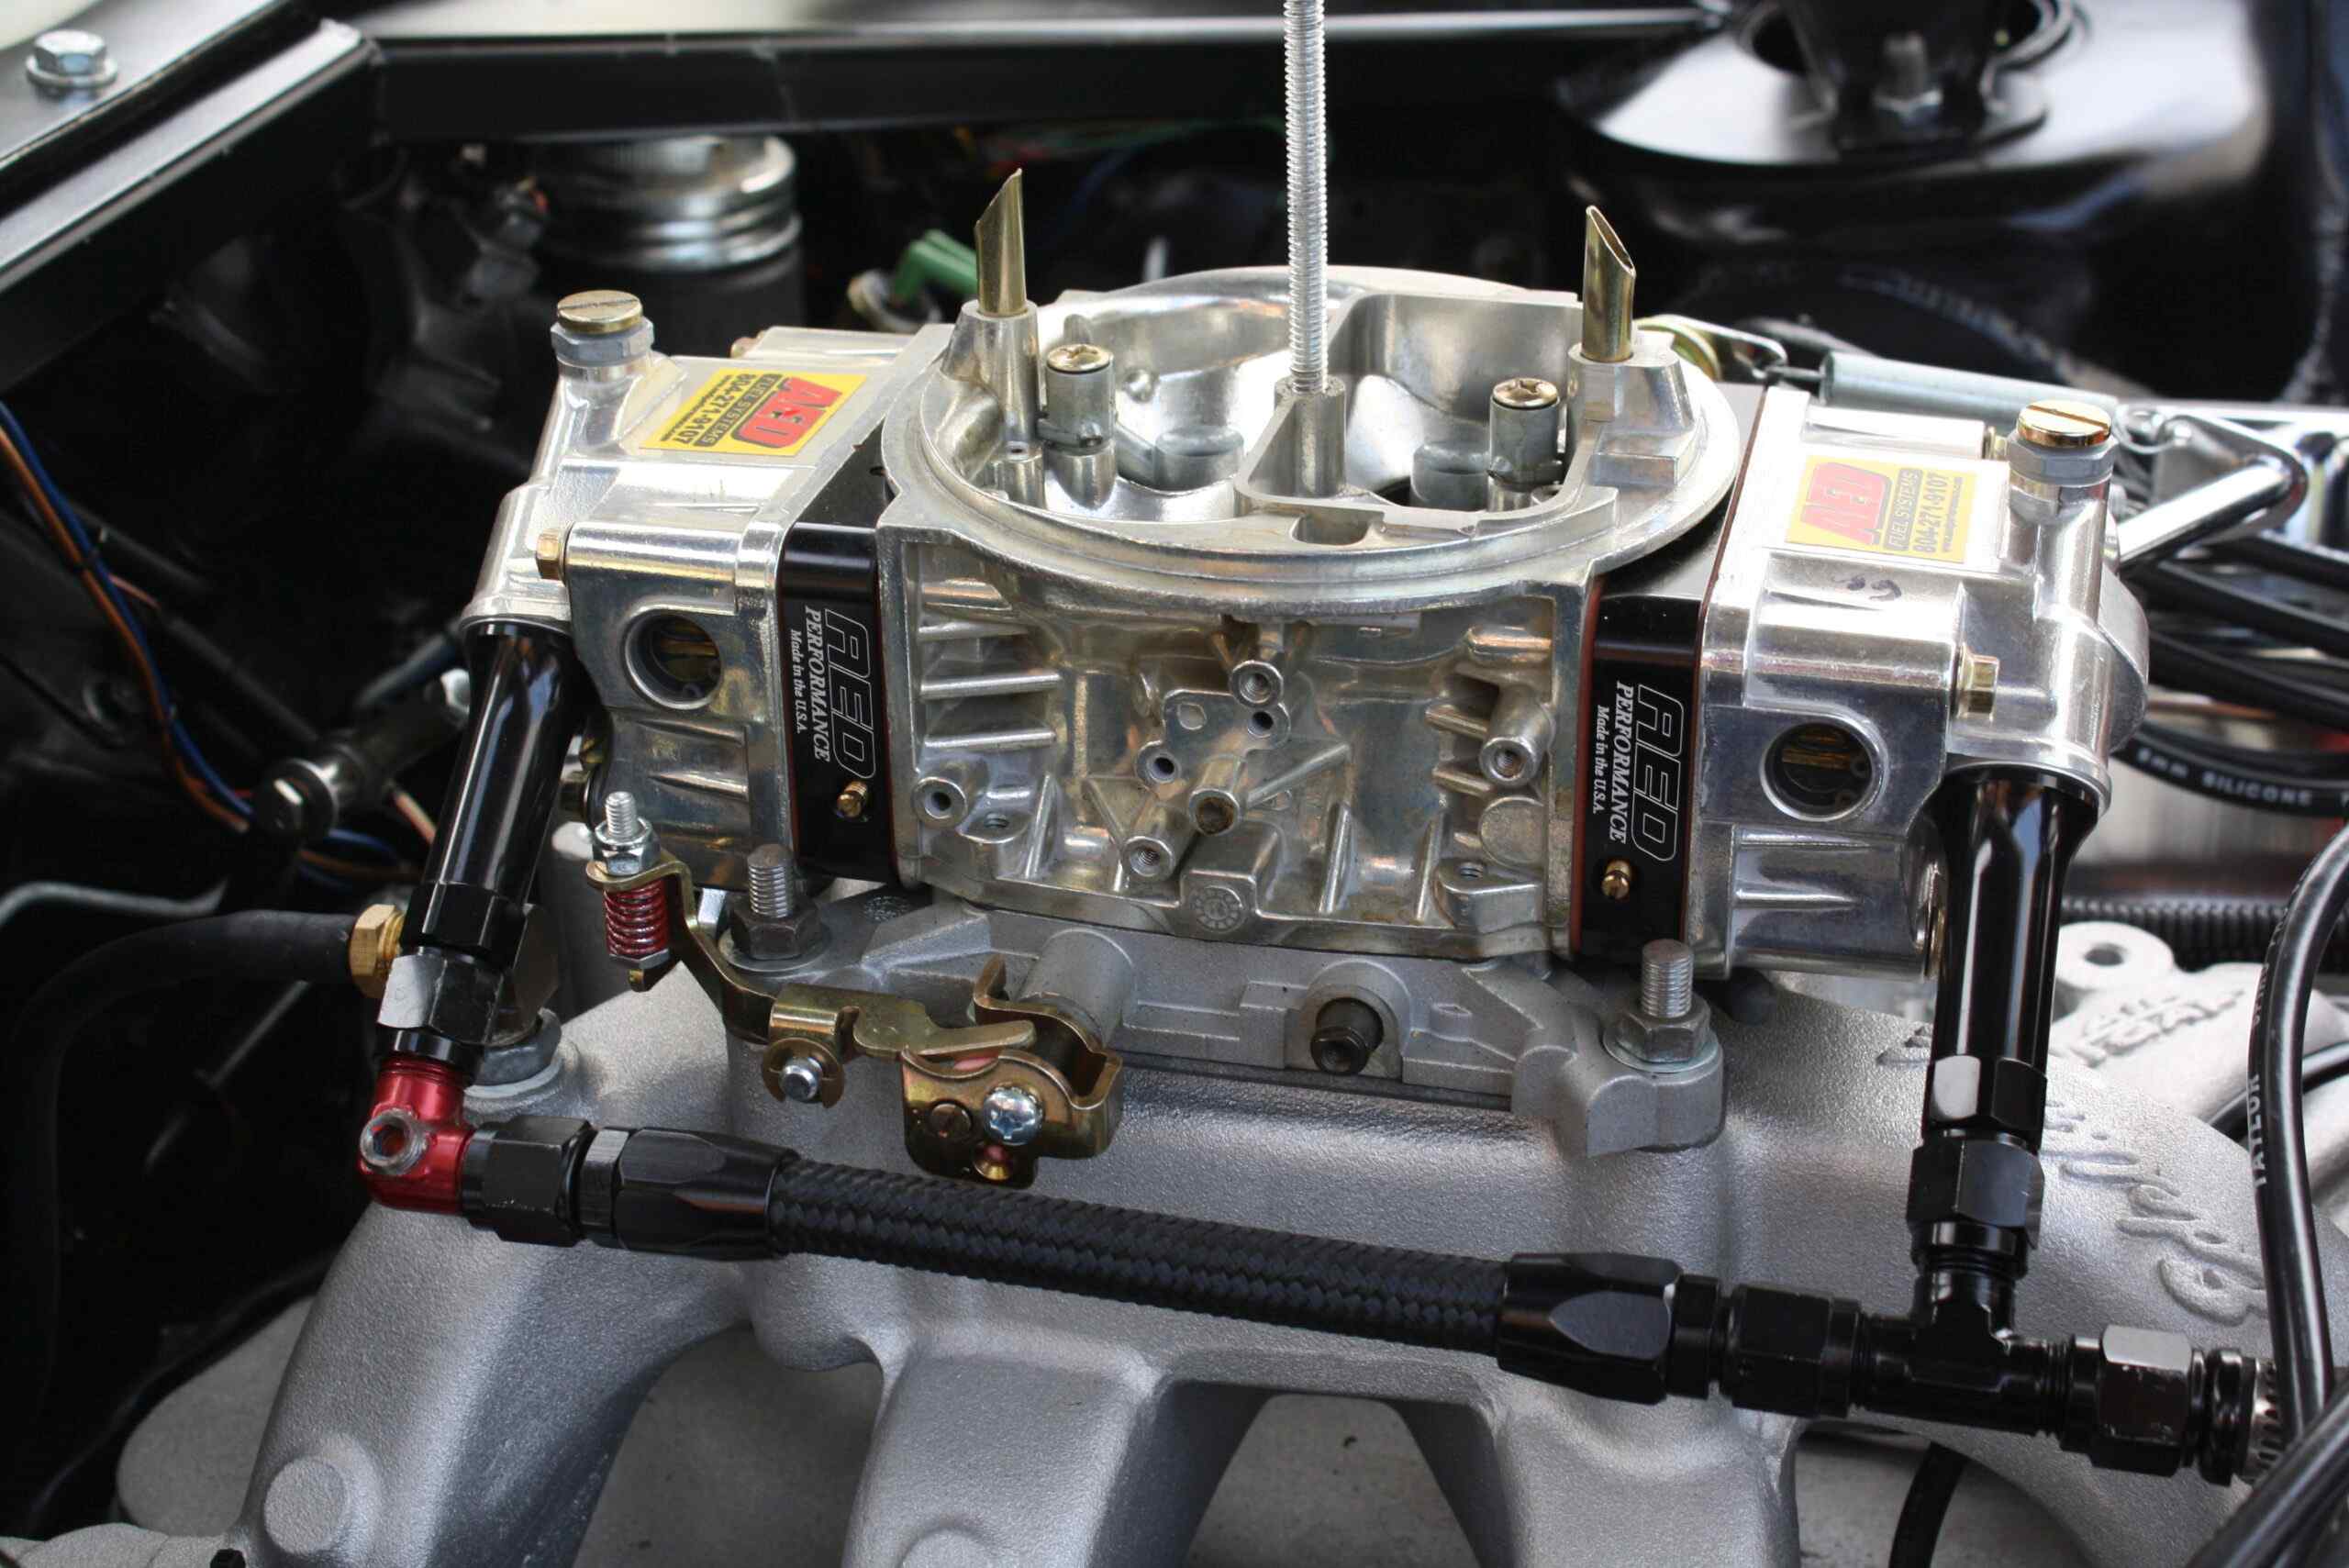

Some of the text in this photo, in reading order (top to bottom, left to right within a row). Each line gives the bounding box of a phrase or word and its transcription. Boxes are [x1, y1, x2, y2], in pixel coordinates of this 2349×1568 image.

[705, 400, 755, 444] SYSTEMS
[732, 376, 843, 448] AED
[1800, 462, 1893, 545] AED
[1888, 472, 1918, 548] FUEL SYSTEMS
[1912, 472, 1948, 552] 804-271-9107
[791, 628, 804, 663] Made
[792, 664, 805, 677] in
[794, 677, 807, 698] the
[805, 606, 830, 762] PERFORMANCE
[825, 608, 876, 779] AED
[1596, 742, 1609, 755] in
[1597, 705, 1609, 740] Made
[1595, 757, 1609, 776] the
[1609, 680, 1634, 844] PERFORMANCE
[1631, 684, 1684, 862] AED
[2202, 770, 2312, 806] SILICONE
